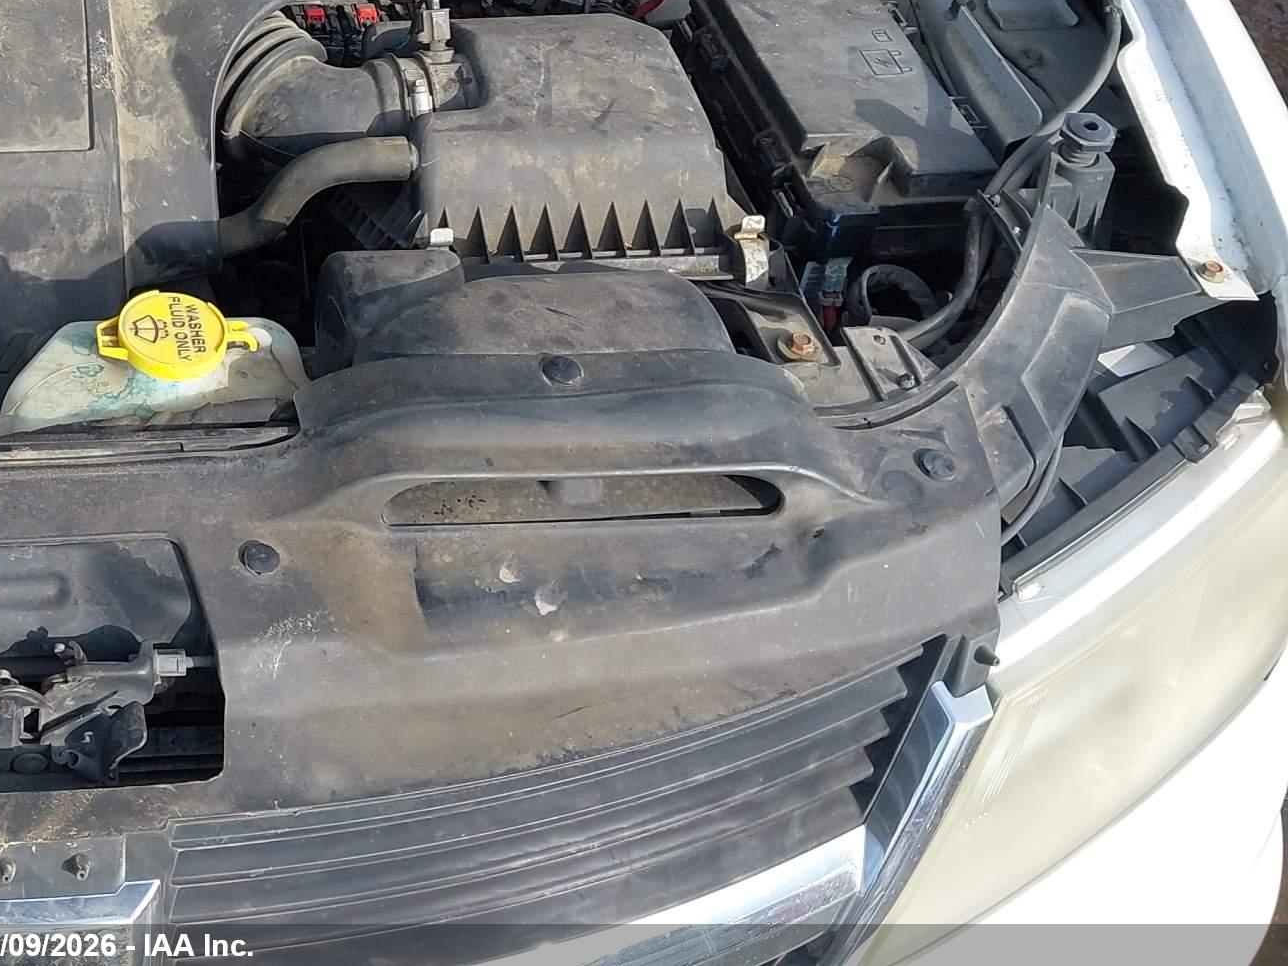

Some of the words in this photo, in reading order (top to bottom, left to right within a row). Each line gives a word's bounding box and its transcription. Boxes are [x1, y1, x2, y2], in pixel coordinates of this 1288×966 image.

[167, 296, 186, 329] FLUID
[184, 303, 207, 354] WASHER
[175, 330, 193, 362] ONLY
